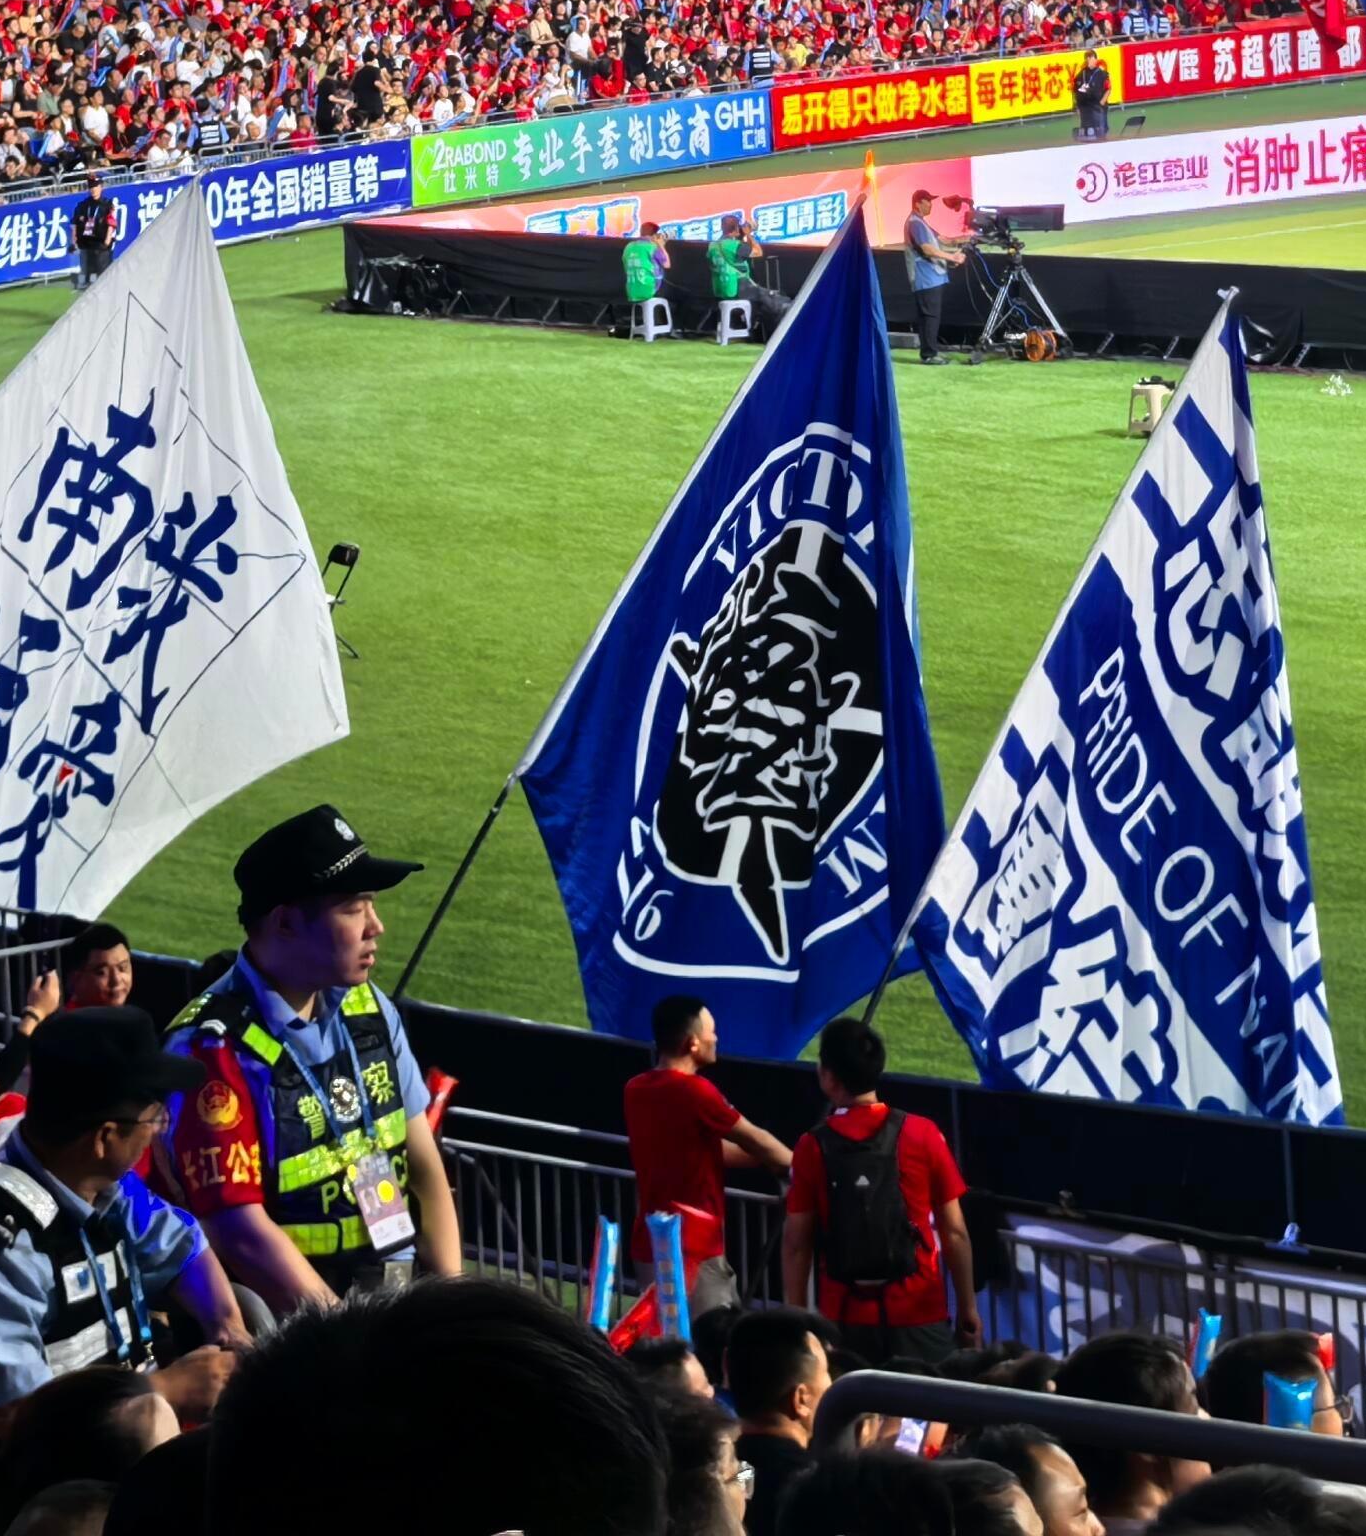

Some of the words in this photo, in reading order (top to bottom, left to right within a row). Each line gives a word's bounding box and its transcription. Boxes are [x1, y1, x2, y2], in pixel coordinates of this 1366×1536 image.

[1211, 28, 1322, 85] 苏超很酷
[714, 96, 765, 131] GHH
[781, 74, 968, 136] 易开得只做净水器
[510, 102, 711, 182] 专业手套制造商
[1077, 647, 1177, 865] PRIDE
[1154, 844, 1250, 950] OF
